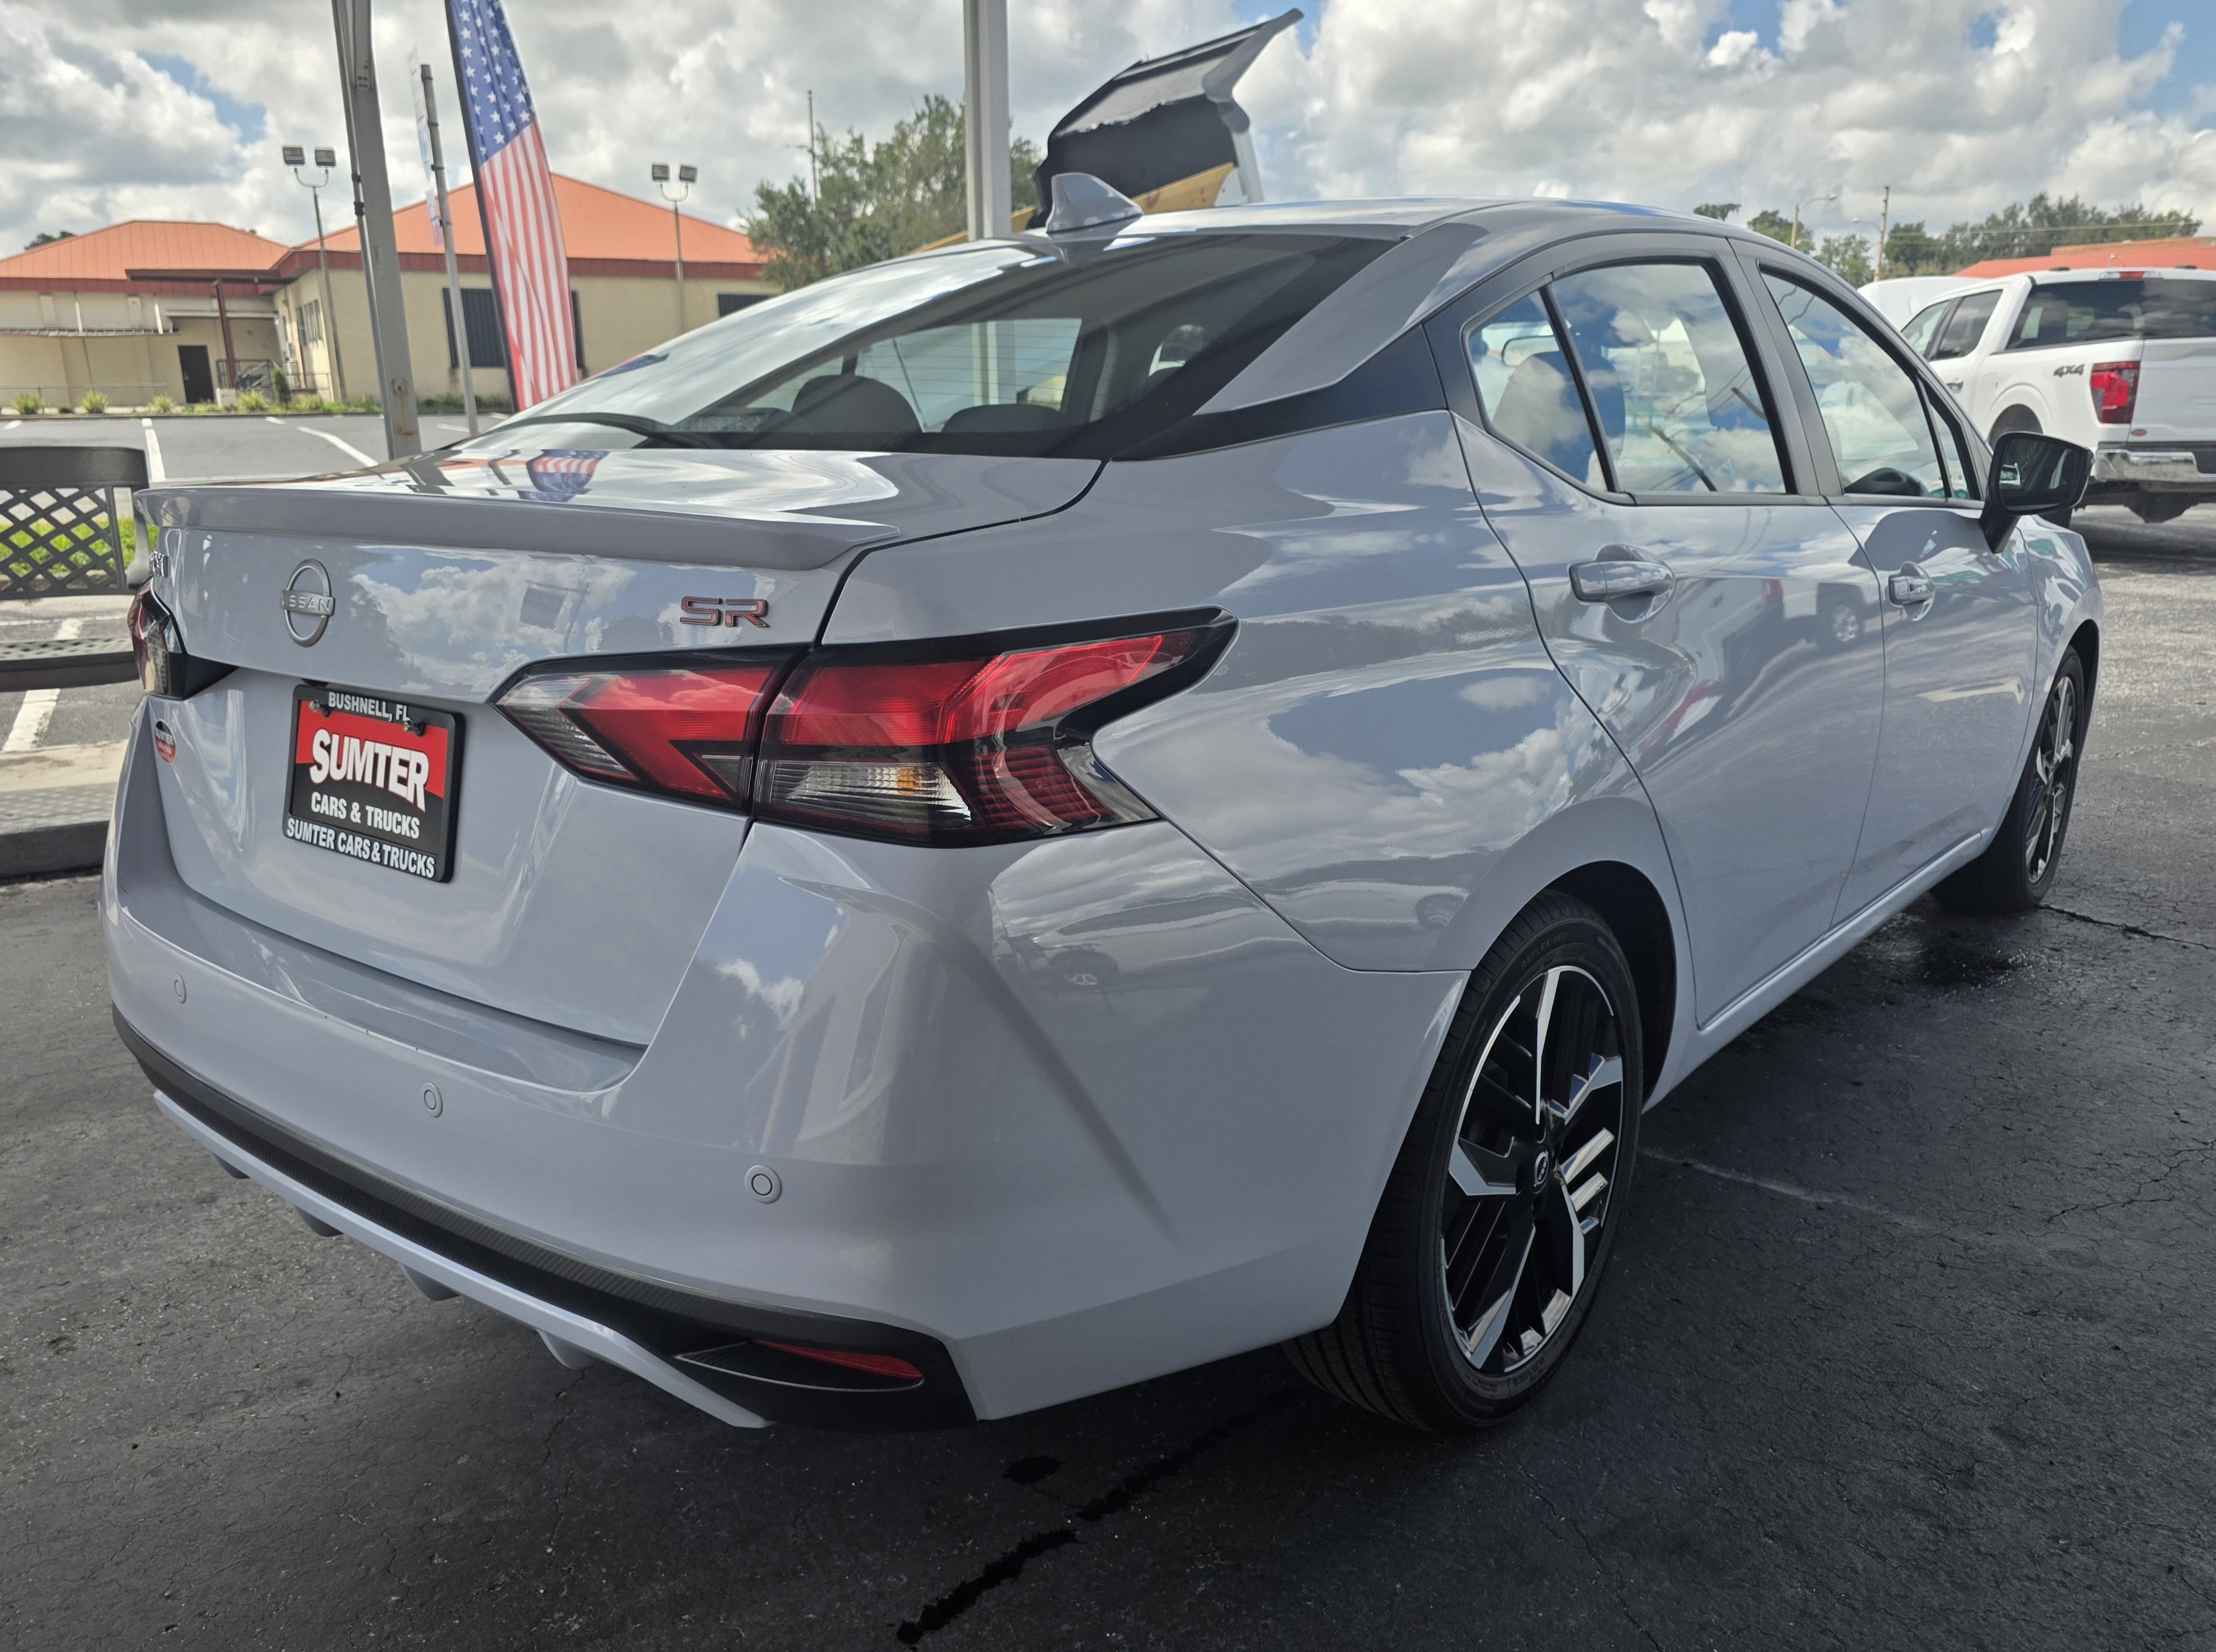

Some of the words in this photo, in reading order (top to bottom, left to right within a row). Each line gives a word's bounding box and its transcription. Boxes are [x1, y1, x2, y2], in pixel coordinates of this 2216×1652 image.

[287, 595, 332, 613] SSAN
[680, 596, 771, 628] SR
[328, 692, 393, 722] BUSHNELL,
[396, 703, 411, 722] FL
[310, 728, 429, 813] SUMTER
[311, 791, 347, 820] CARS
[350, 802, 361, 824] &
[366, 805, 421, 839] TRUCKS
[287, 818, 336, 850] SUMTER
[337, 832, 371, 861] CARS
[371, 841, 381, 863] &
[383, 845, 435, 879] TRUCKS
[1522, 938, 1551, 970] REFLEX
